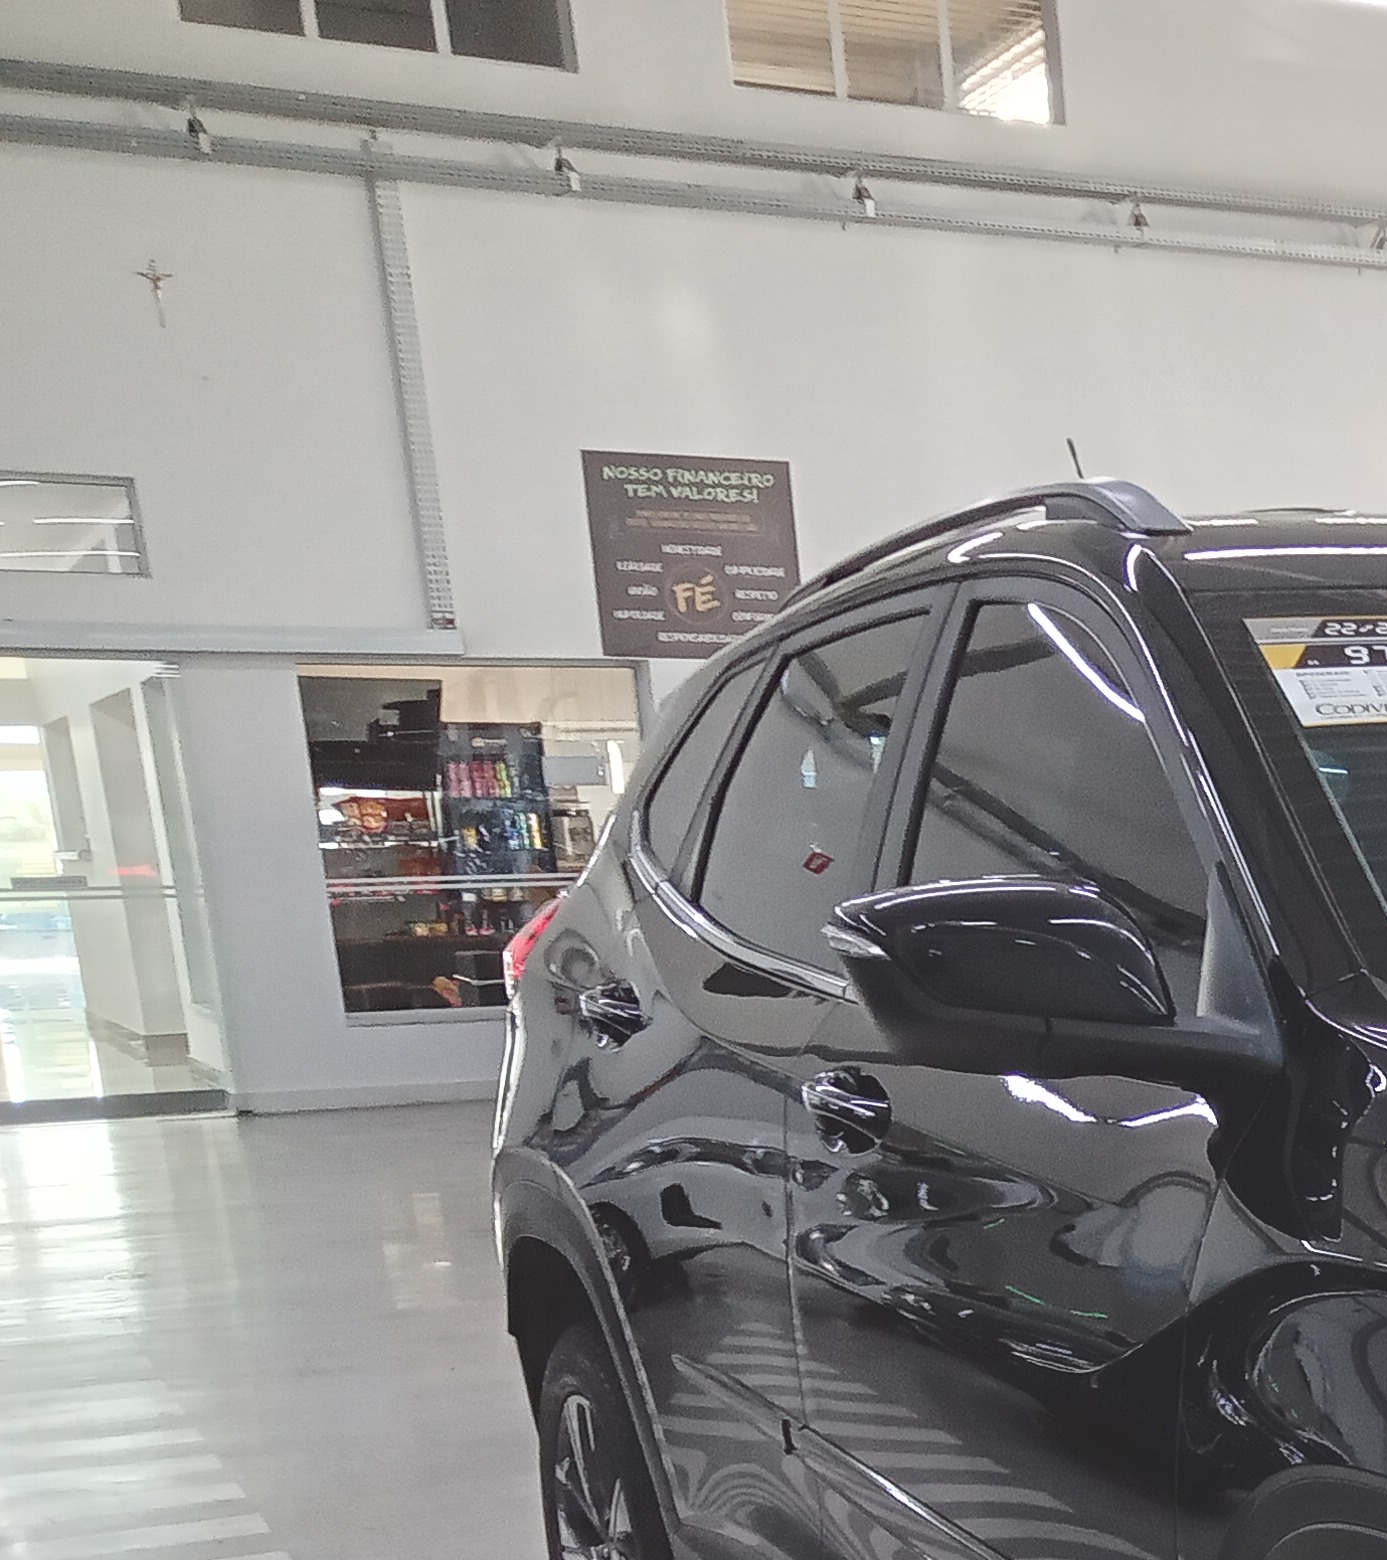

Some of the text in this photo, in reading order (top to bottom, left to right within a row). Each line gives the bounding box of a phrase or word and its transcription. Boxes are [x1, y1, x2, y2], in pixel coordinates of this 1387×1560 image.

[602, 465, 775, 488] NOSSO FINANCEIRO
[624, 484, 668, 498] TEM
[671, 574, 721, 613] FÉ
